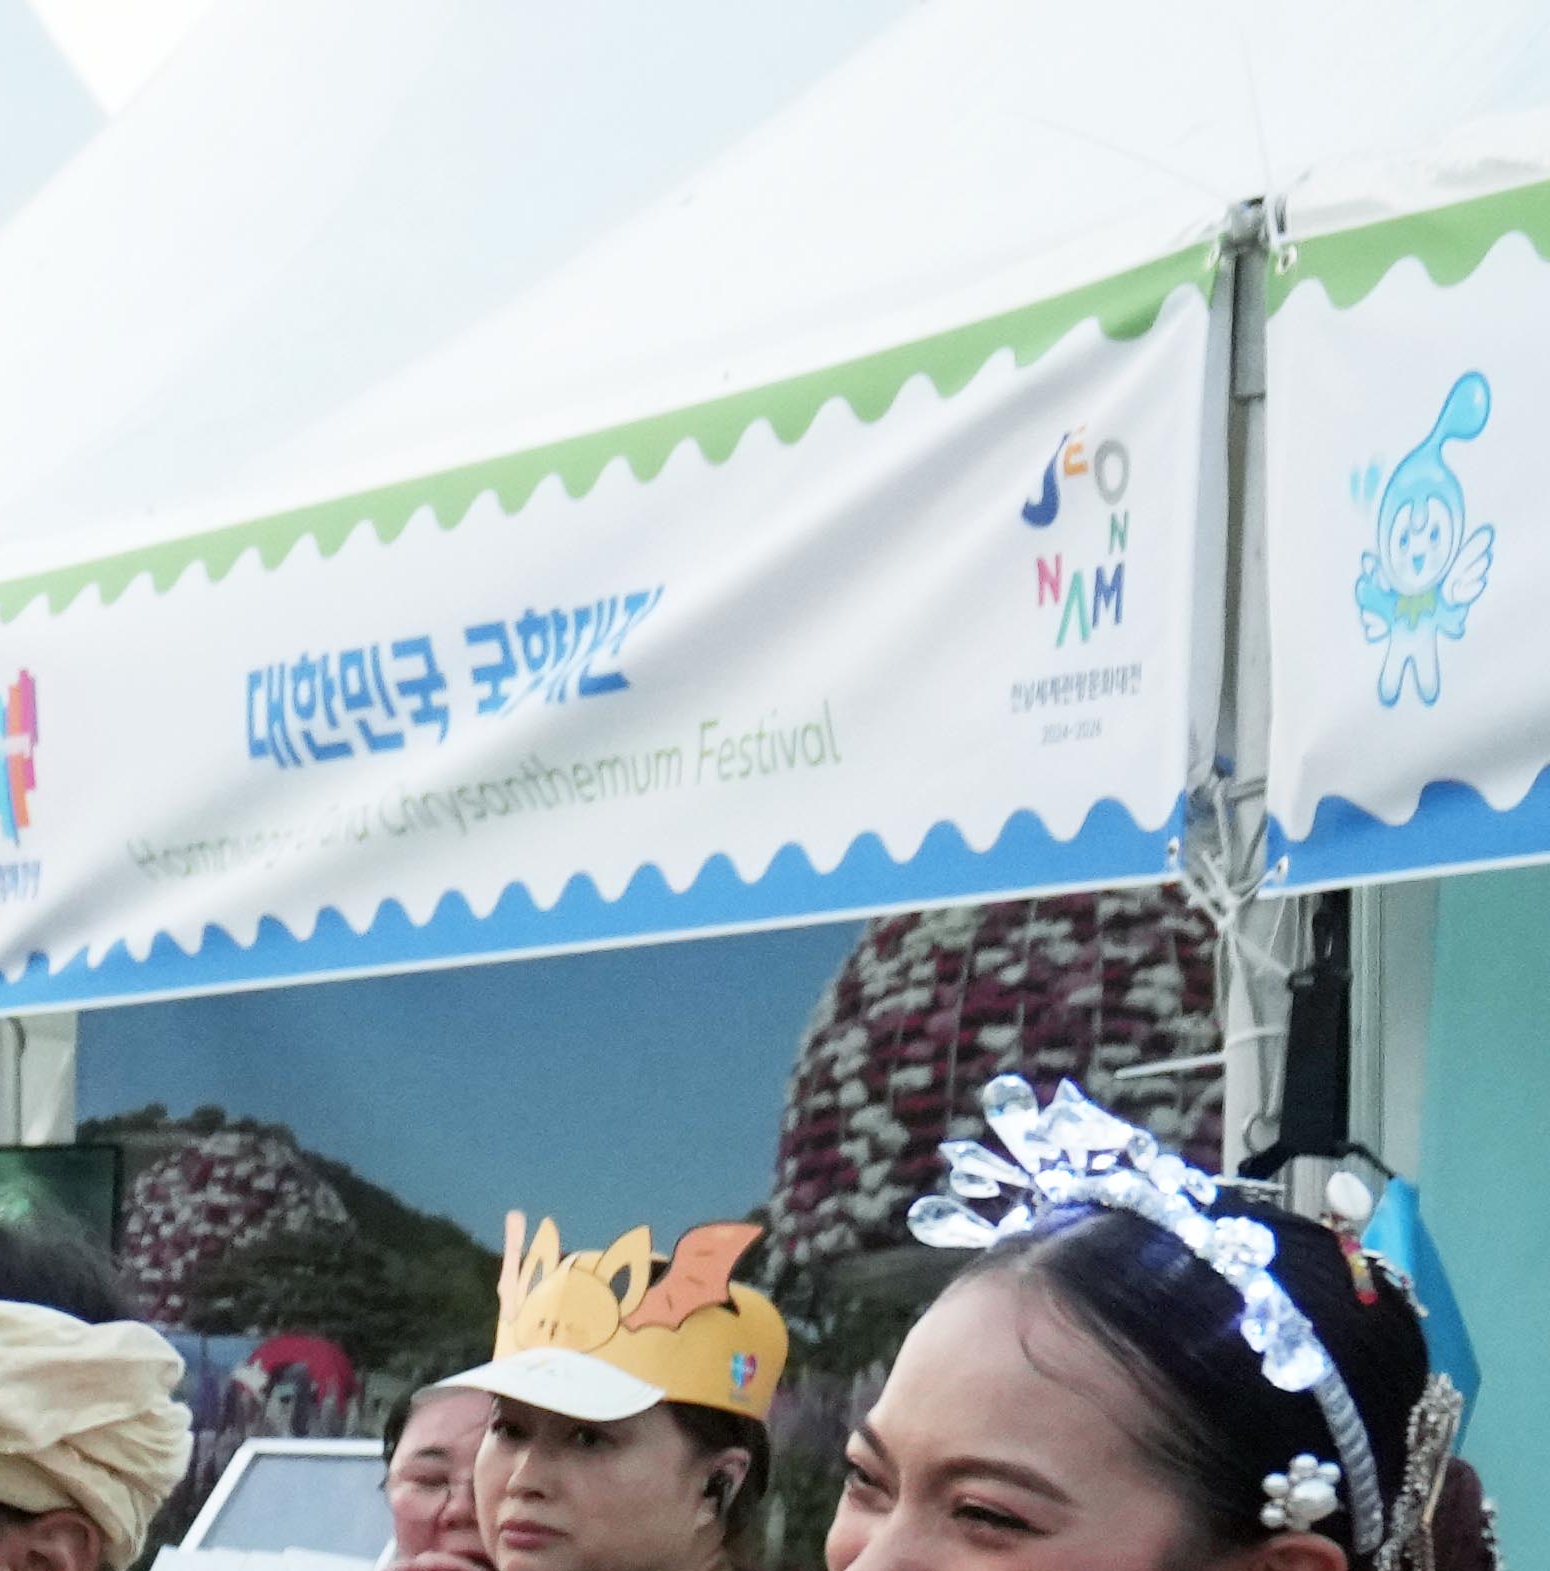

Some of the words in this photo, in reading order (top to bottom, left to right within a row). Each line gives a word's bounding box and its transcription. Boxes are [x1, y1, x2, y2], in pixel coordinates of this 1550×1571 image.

[246, 634, 449, 769] 대한민국
[378, 743, 685, 838] Chrysanthemum
[696, 698, 842, 786] Festival
